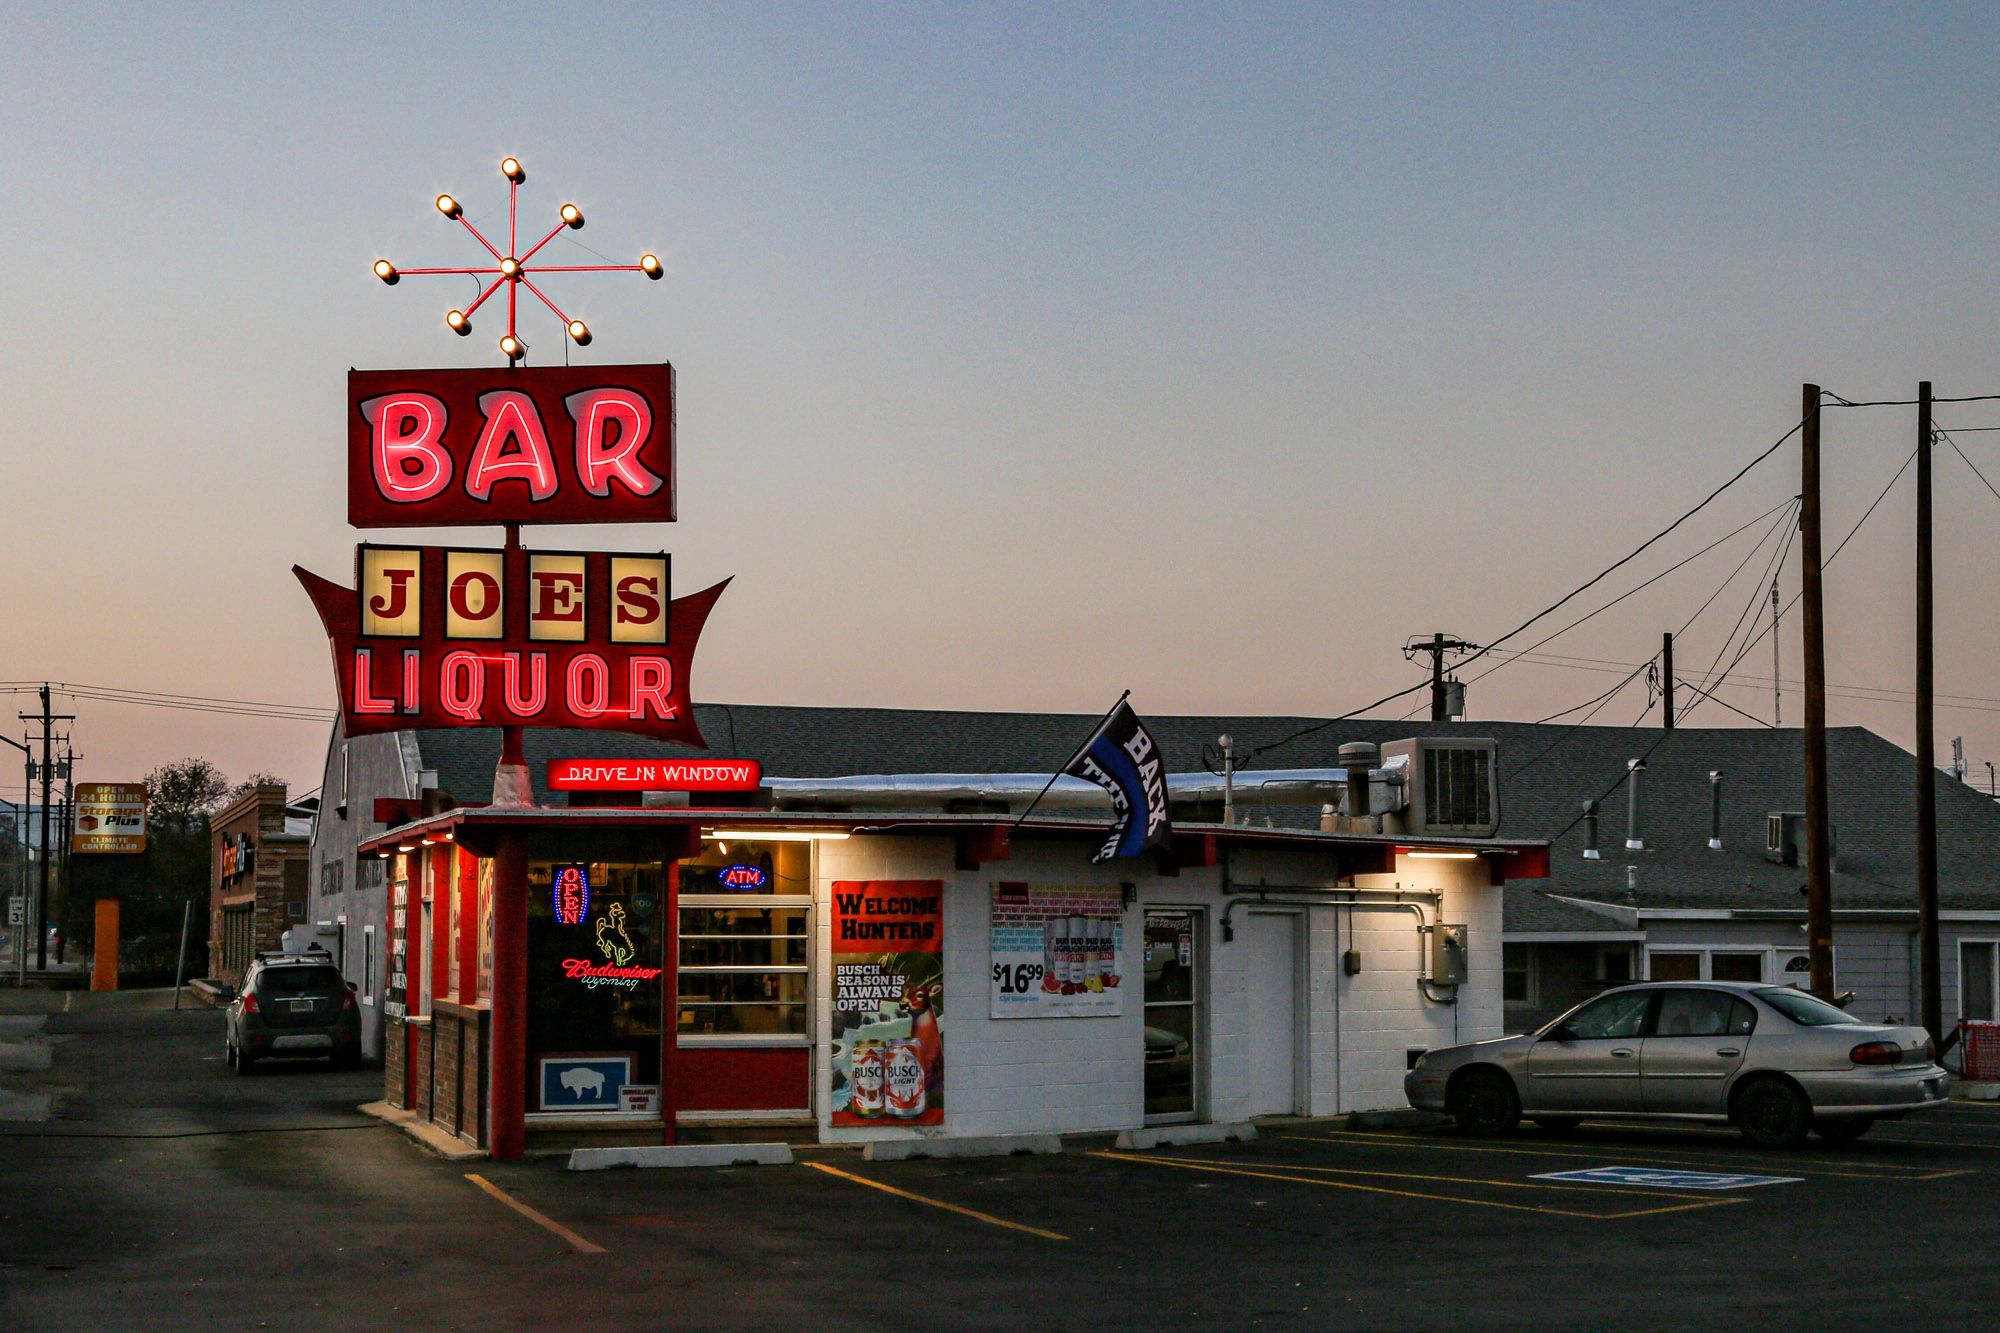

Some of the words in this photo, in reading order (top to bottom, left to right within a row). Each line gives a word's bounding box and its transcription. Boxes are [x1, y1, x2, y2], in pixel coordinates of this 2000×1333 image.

[360, 388, 663, 502] BAR
[369, 569, 661, 625] JOES
[354, 648, 676, 720] LIQUOR
[569, 767, 627, 781] DRIVE
[663, 767, 749, 781] WINDOW
[1123, 726, 1167, 836] BACK
[80, 794, 96, 802] 24
[100, 794, 141, 802] HOURS
[78, 805, 143, 817] Storage
[105, 815, 140, 826] Plus
[726, 870, 760, 884] ATM
[563, 868, 579, 924] OPEN
[835, 893, 939, 915] WELCOME
[840, 918, 935, 940] HUNTERS
[562, 958, 662, 979] Budweiser
[836, 965, 881, 975] BUSCH
[581, 974, 641, 991] Wyoming
[837, 975, 890, 986] SEASON
[891, 975, 905, 985] IS
[837, 986, 903, 998] ALWAYS
[836, 999, 880, 1012] OPEN
